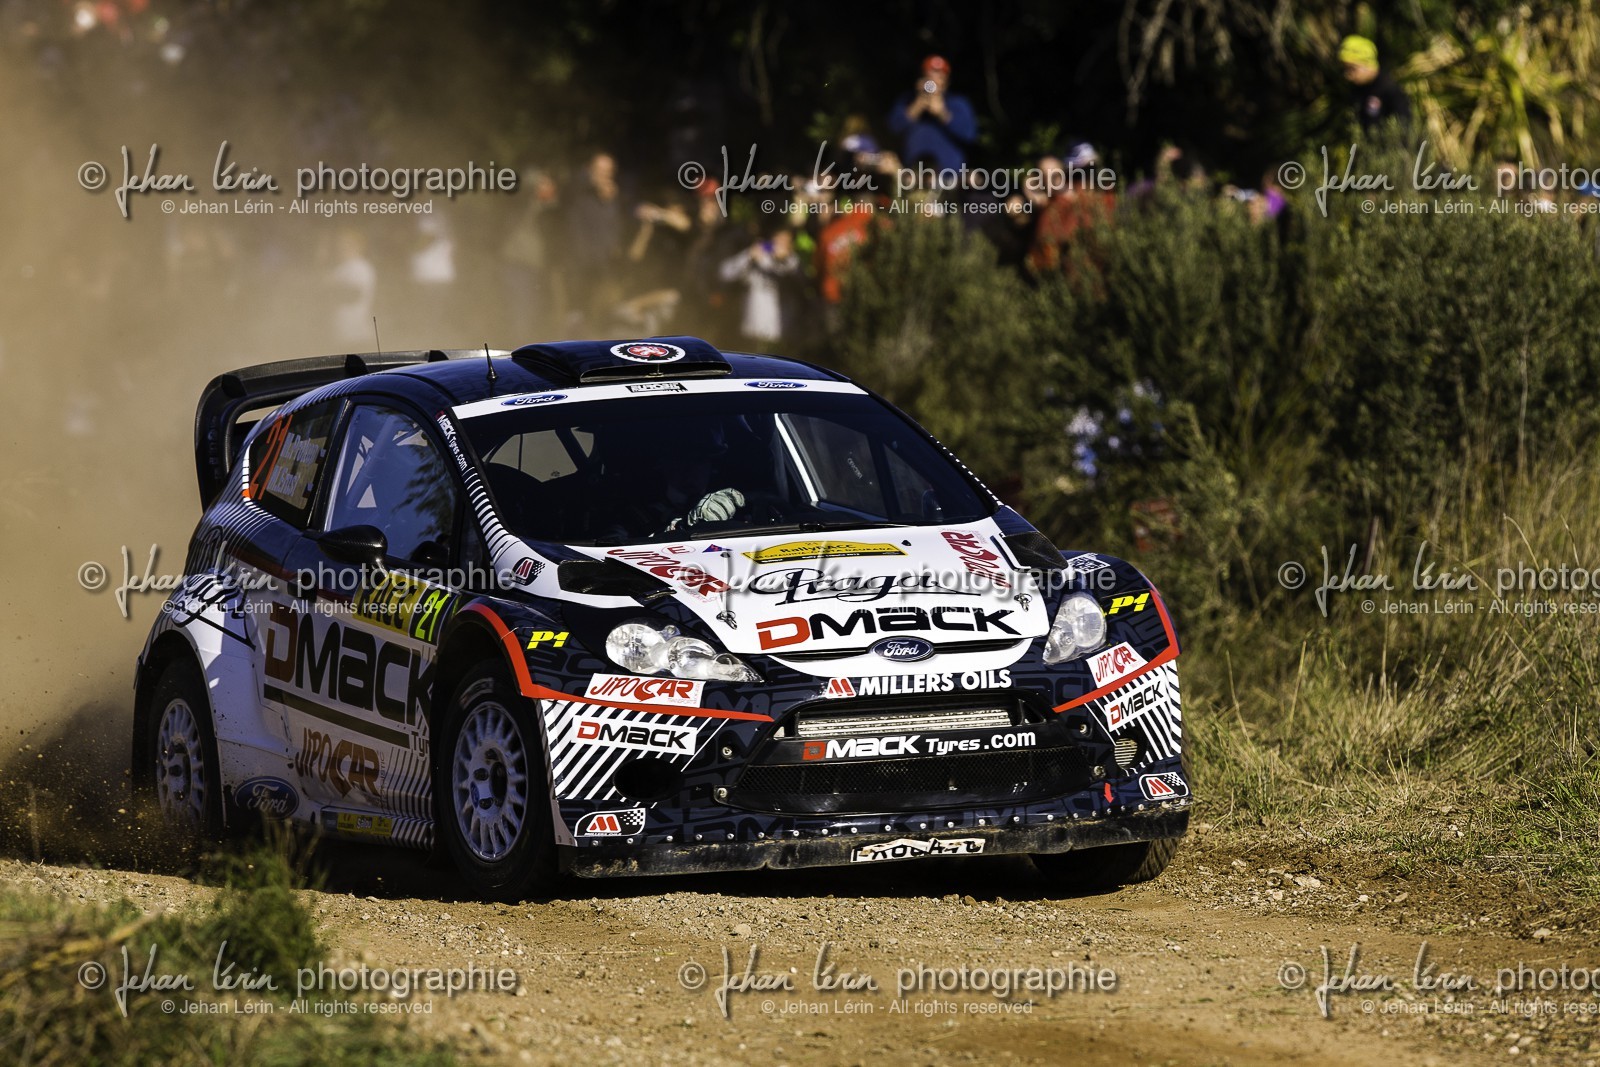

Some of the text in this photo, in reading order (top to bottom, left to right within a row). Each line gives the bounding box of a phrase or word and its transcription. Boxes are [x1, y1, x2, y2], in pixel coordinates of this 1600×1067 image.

[514, 395, 556, 405] Ford
[1108, 592, 1150, 615] P1
[415, 589, 449, 642] 21
[527, 631, 569, 649] P1
[884, 641, 920, 657] Ford
[858, 669, 1012, 696] MILLERS OILS
[247, 783, 288, 814] Ford
